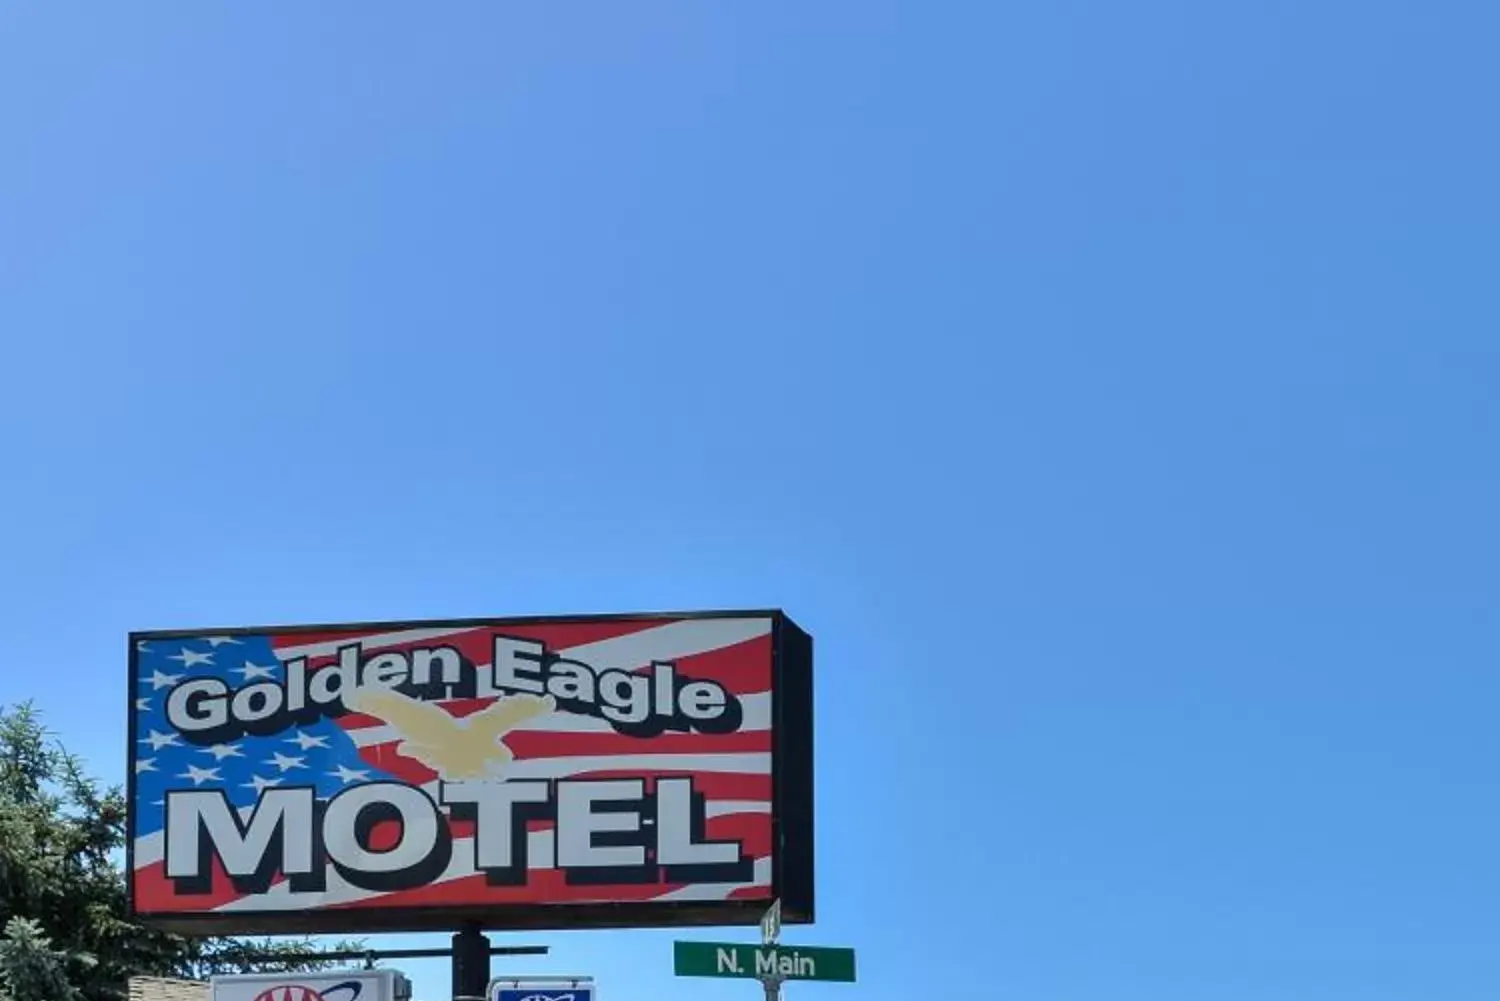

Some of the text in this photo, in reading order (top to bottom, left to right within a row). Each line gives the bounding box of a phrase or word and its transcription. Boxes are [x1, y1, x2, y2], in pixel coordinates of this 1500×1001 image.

[165, 634, 736, 738] Golden Eagle
[164, 776, 742, 886] MOTEL
[716, 948, 816, 977] N. Main
